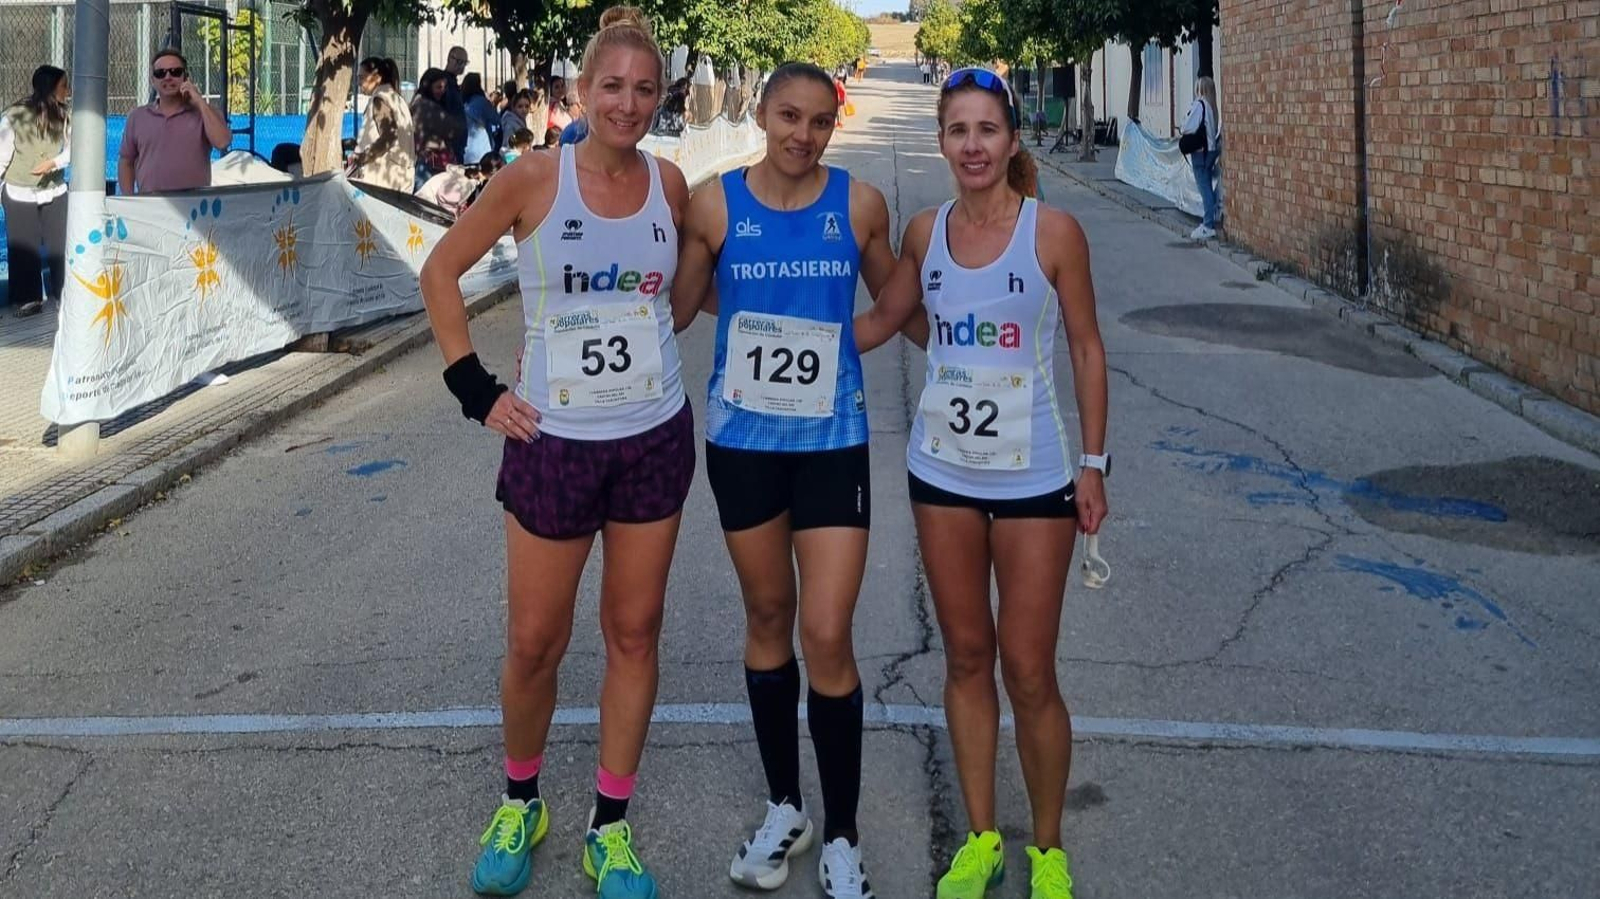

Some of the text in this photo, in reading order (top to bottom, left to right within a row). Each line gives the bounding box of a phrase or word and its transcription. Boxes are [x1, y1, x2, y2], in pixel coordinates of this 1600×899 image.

[653, 222, 667, 243] in
[735, 217, 762, 237] als
[563, 262, 663, 296] indea
[731, 260, 851, 280] TROTASIERRA
[1008, 272, 1024, 293] in
[935, 313, 1020, 348] indea
[581, 335, 632, 377] 53
[746, 345, 820, 385] 129
[948, 397, 999, 437] 32
